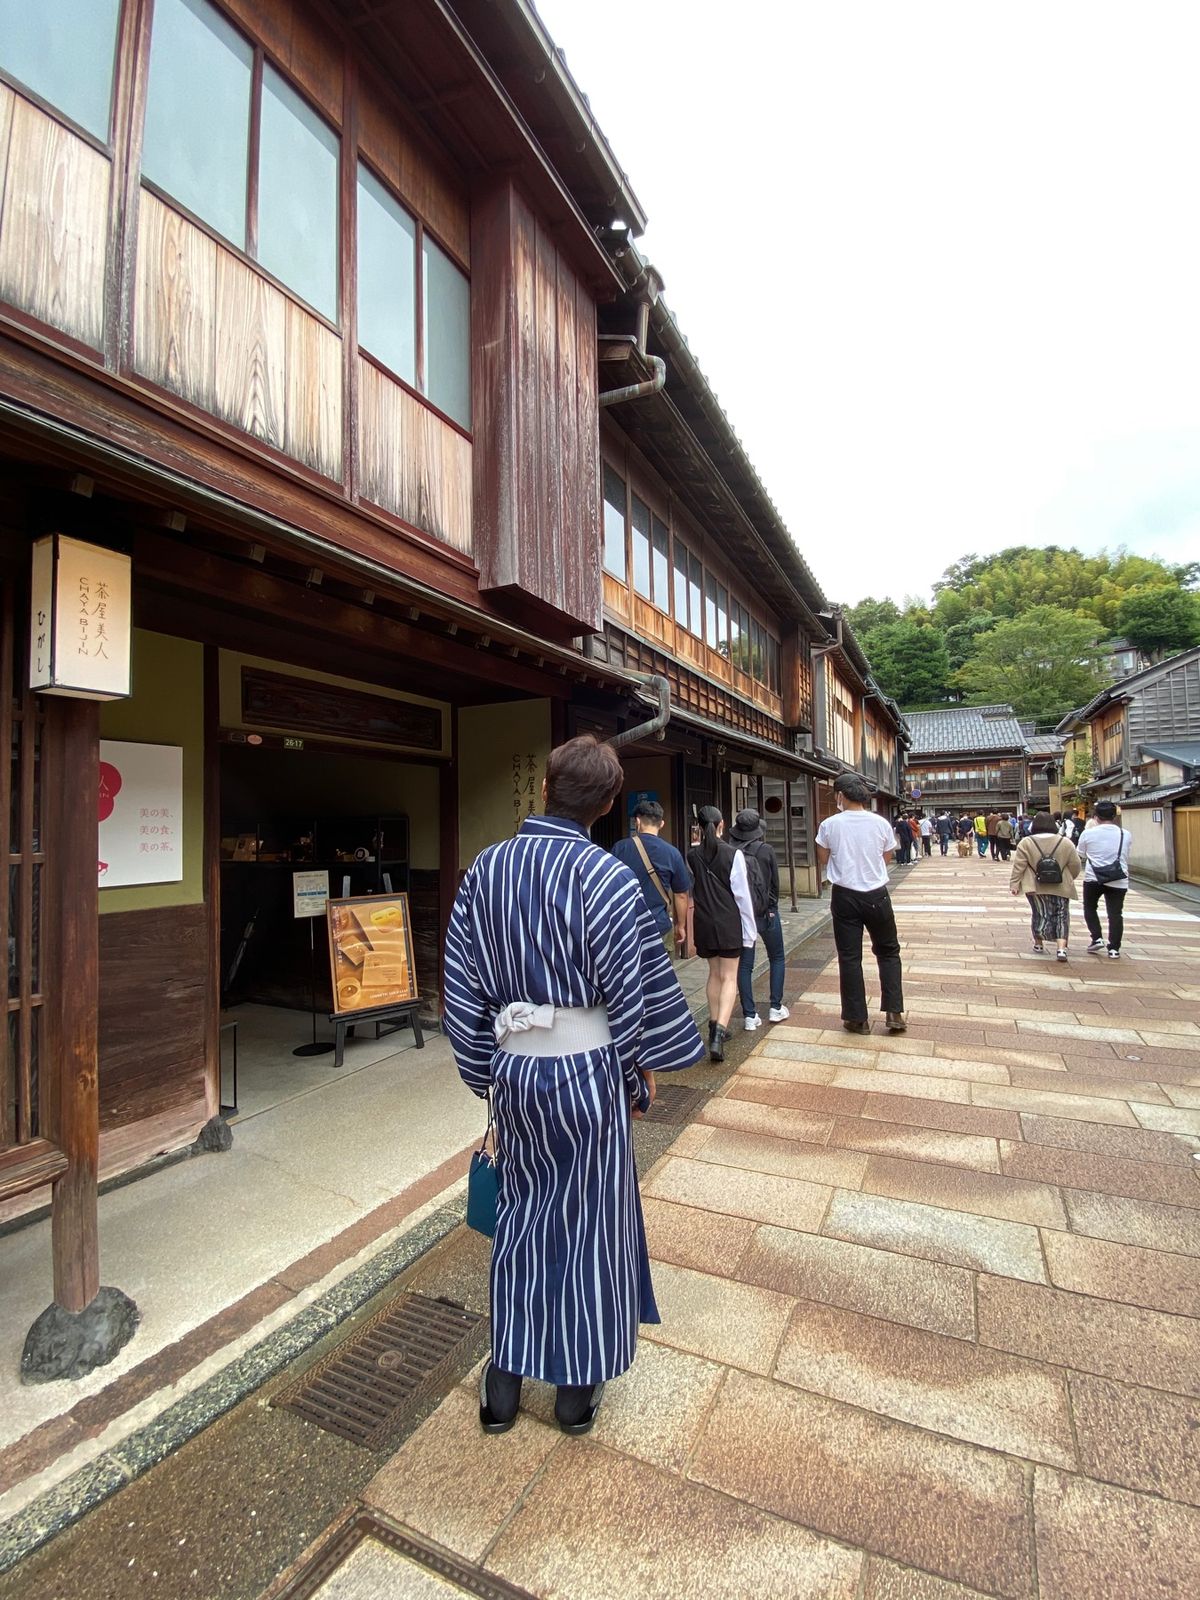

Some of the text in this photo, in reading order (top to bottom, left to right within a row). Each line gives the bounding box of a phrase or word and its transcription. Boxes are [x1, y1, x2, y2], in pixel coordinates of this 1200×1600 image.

[37, 610, 46, 673] ひがし
[79, 577, 89, 655] CHAYA BIJIN
[92, 581, 110, 660] 茶屋美人
[512, 754, 521, 796] CHAYA
[140, 808, 174, 818] 美の美、
[140, 842, 174, 853] 美の茶。
